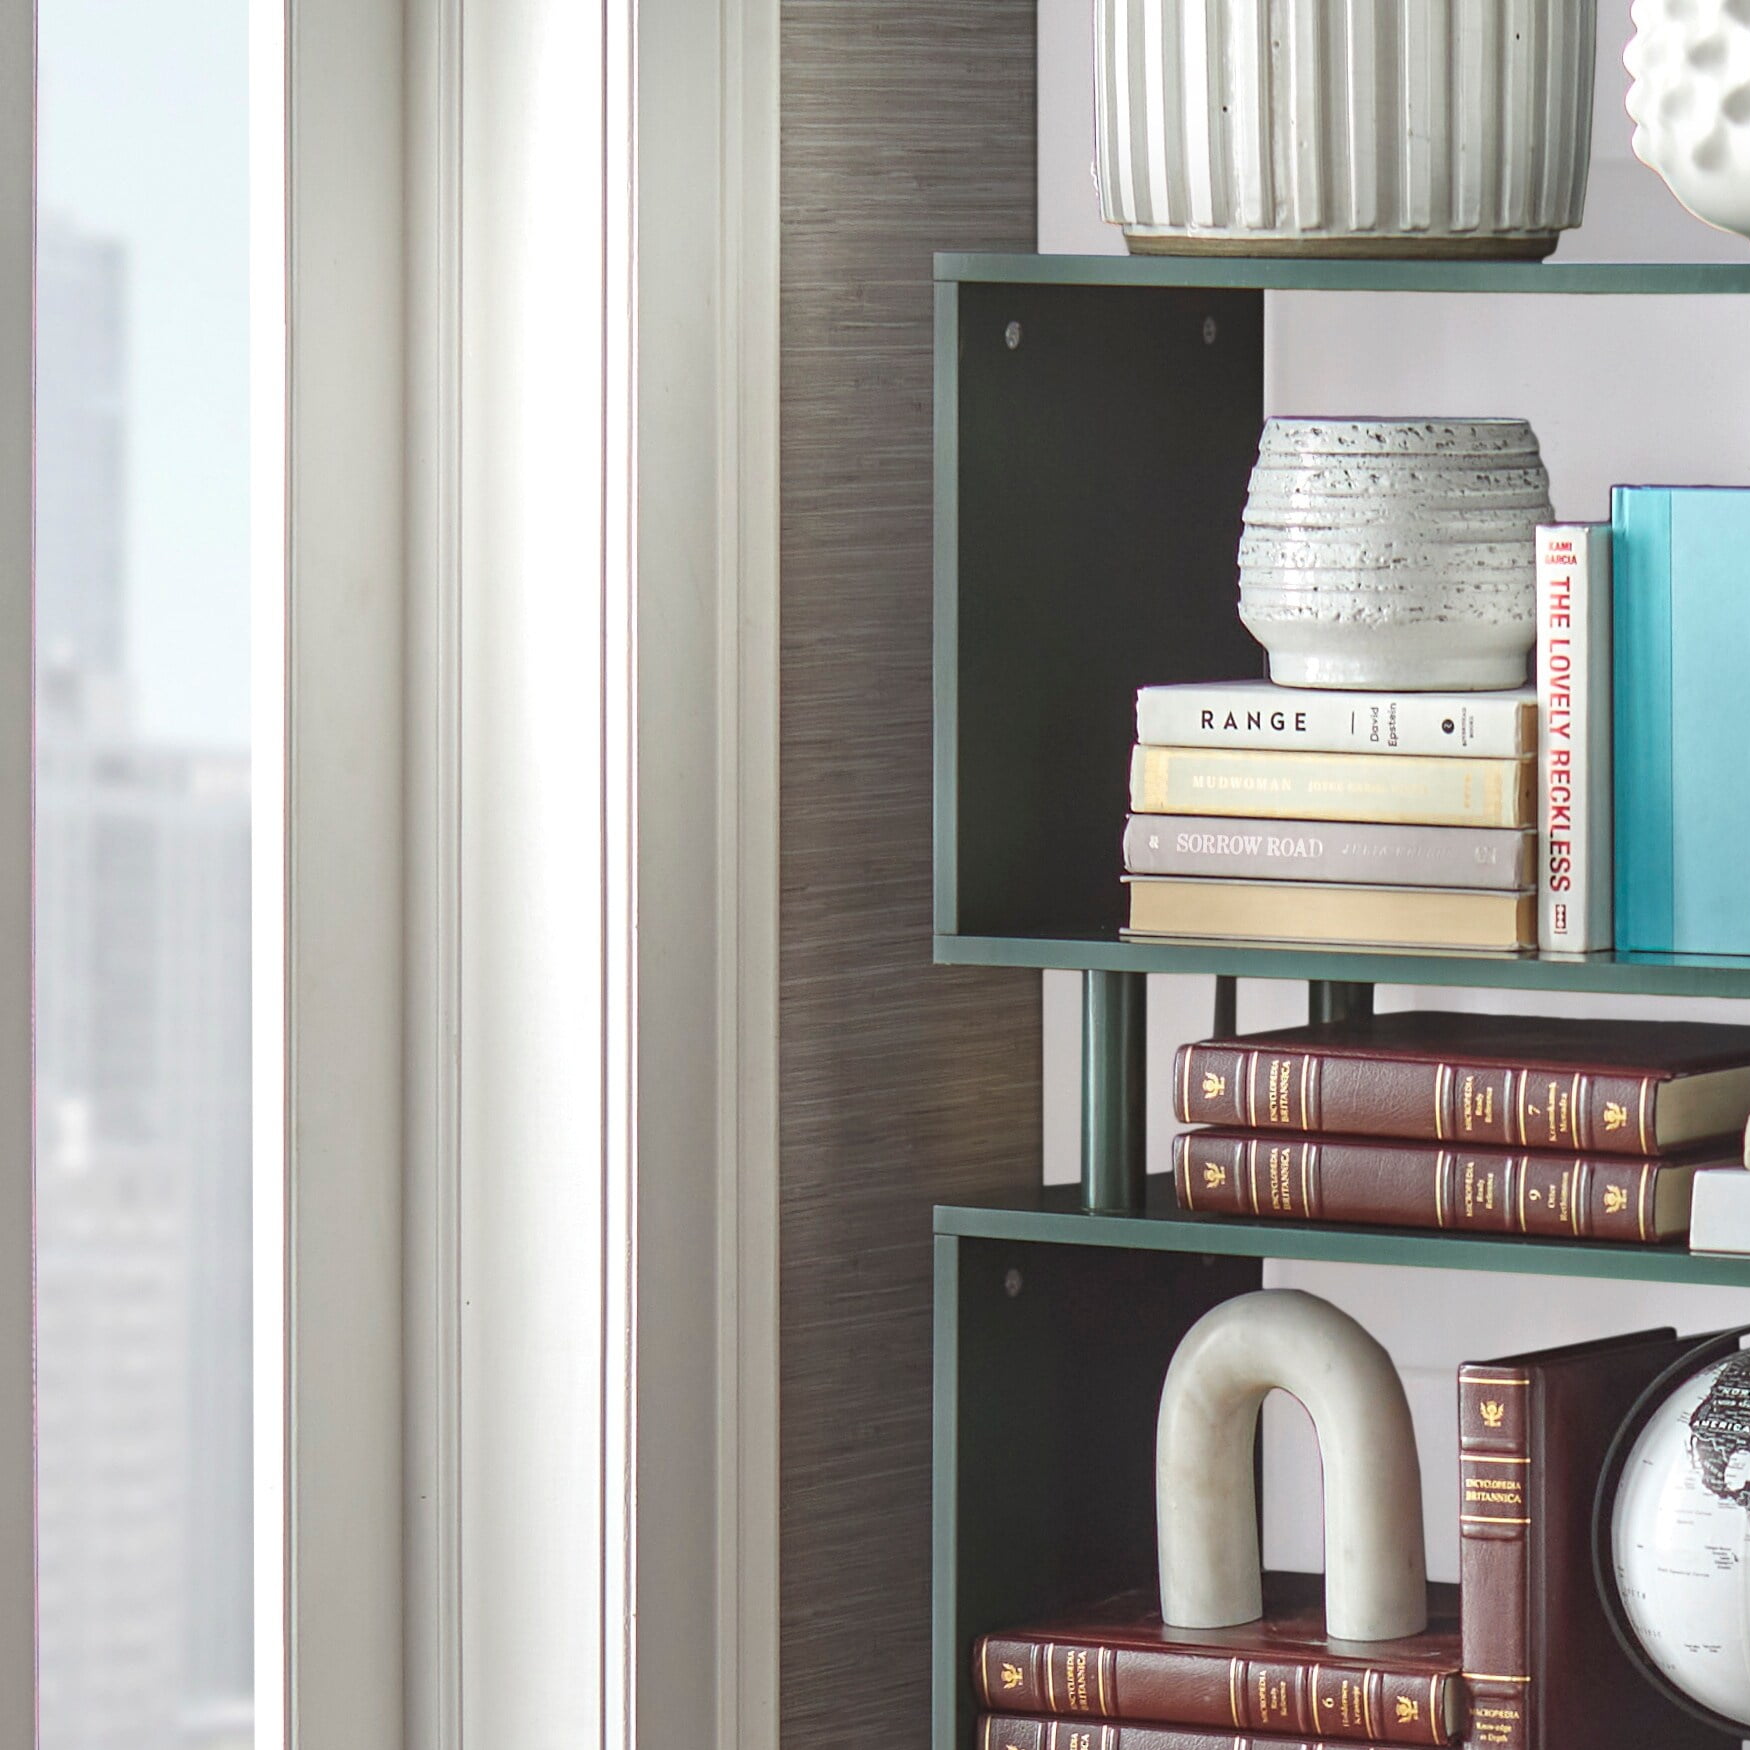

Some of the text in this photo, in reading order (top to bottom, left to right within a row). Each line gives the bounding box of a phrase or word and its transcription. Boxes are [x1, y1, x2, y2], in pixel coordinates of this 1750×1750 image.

[1200, 709, 1308, 733] RANGE
[1369, 706, 1380, 742] David
[1387, 702, 1399, 747] Epstein
[1549, 576, 1571, 892] THE LOVELY RECKLESS
[1192, 775, 1293, 792] MUDWOMAN
[1176, 832, 1323, 858] SORROW ROAD
[1280, 1060, 1291, 1122] BRITANNICA
[1528, 1104, 1541, 1116] 7
[1528, 1189, 1541, 1201] 9
[1693, 1420, 1750, 1433] AMERICA
[1465, 1491, 1522, 1504] BRITANNICA
[1321, 1697, 1334, 1708] 6
